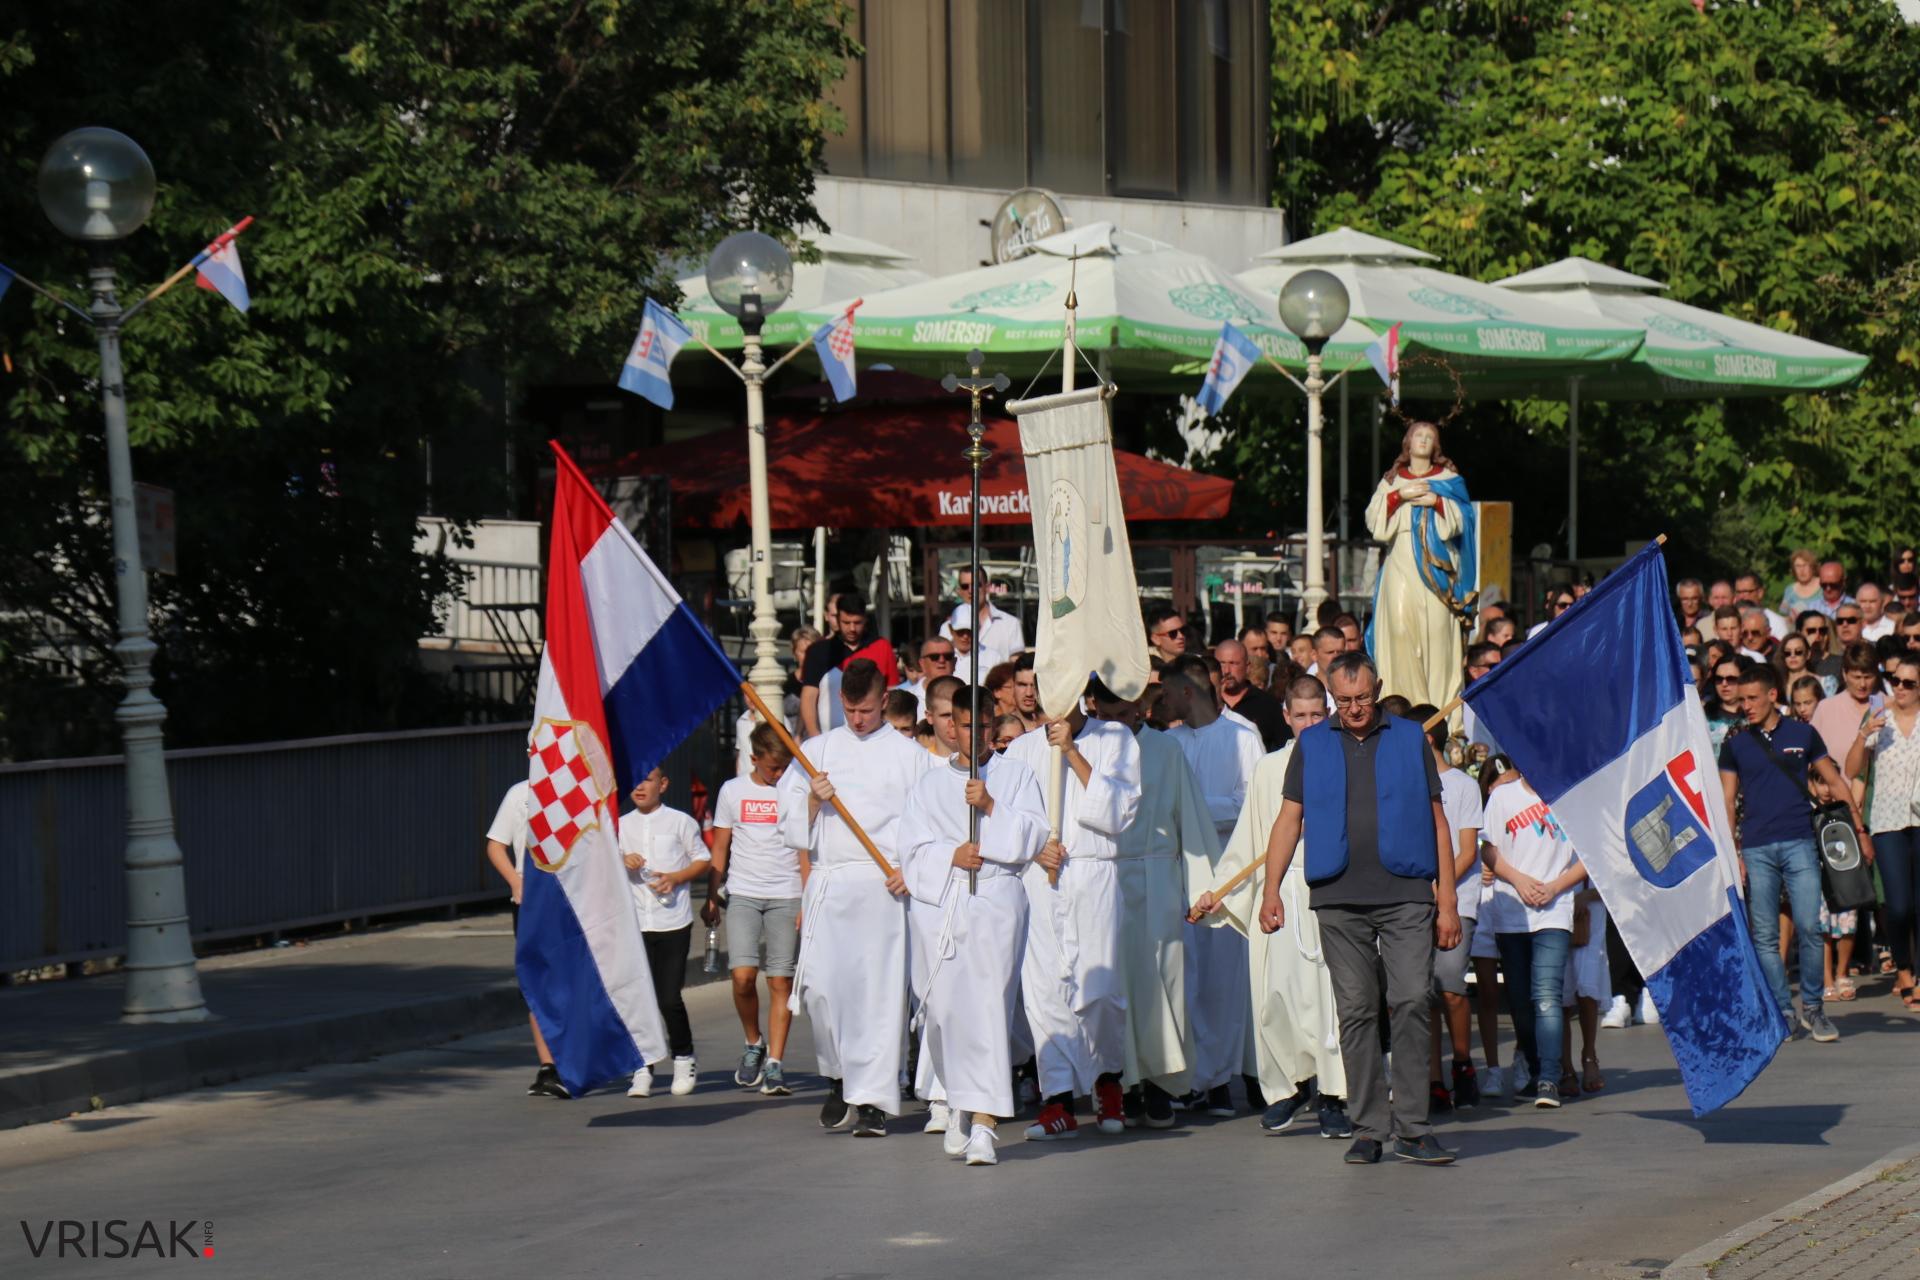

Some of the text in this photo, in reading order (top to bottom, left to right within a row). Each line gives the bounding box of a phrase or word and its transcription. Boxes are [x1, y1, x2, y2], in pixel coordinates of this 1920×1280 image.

[912, 320, 996, 344] SOMERSBY
[1476, 327, 1548, 351] SOMERSBY
[1713, 354, 1777, 379] SOMERSBY
[938, 489, 1031, 515] Karovačk
[744, 801, 778, 813] NASA
